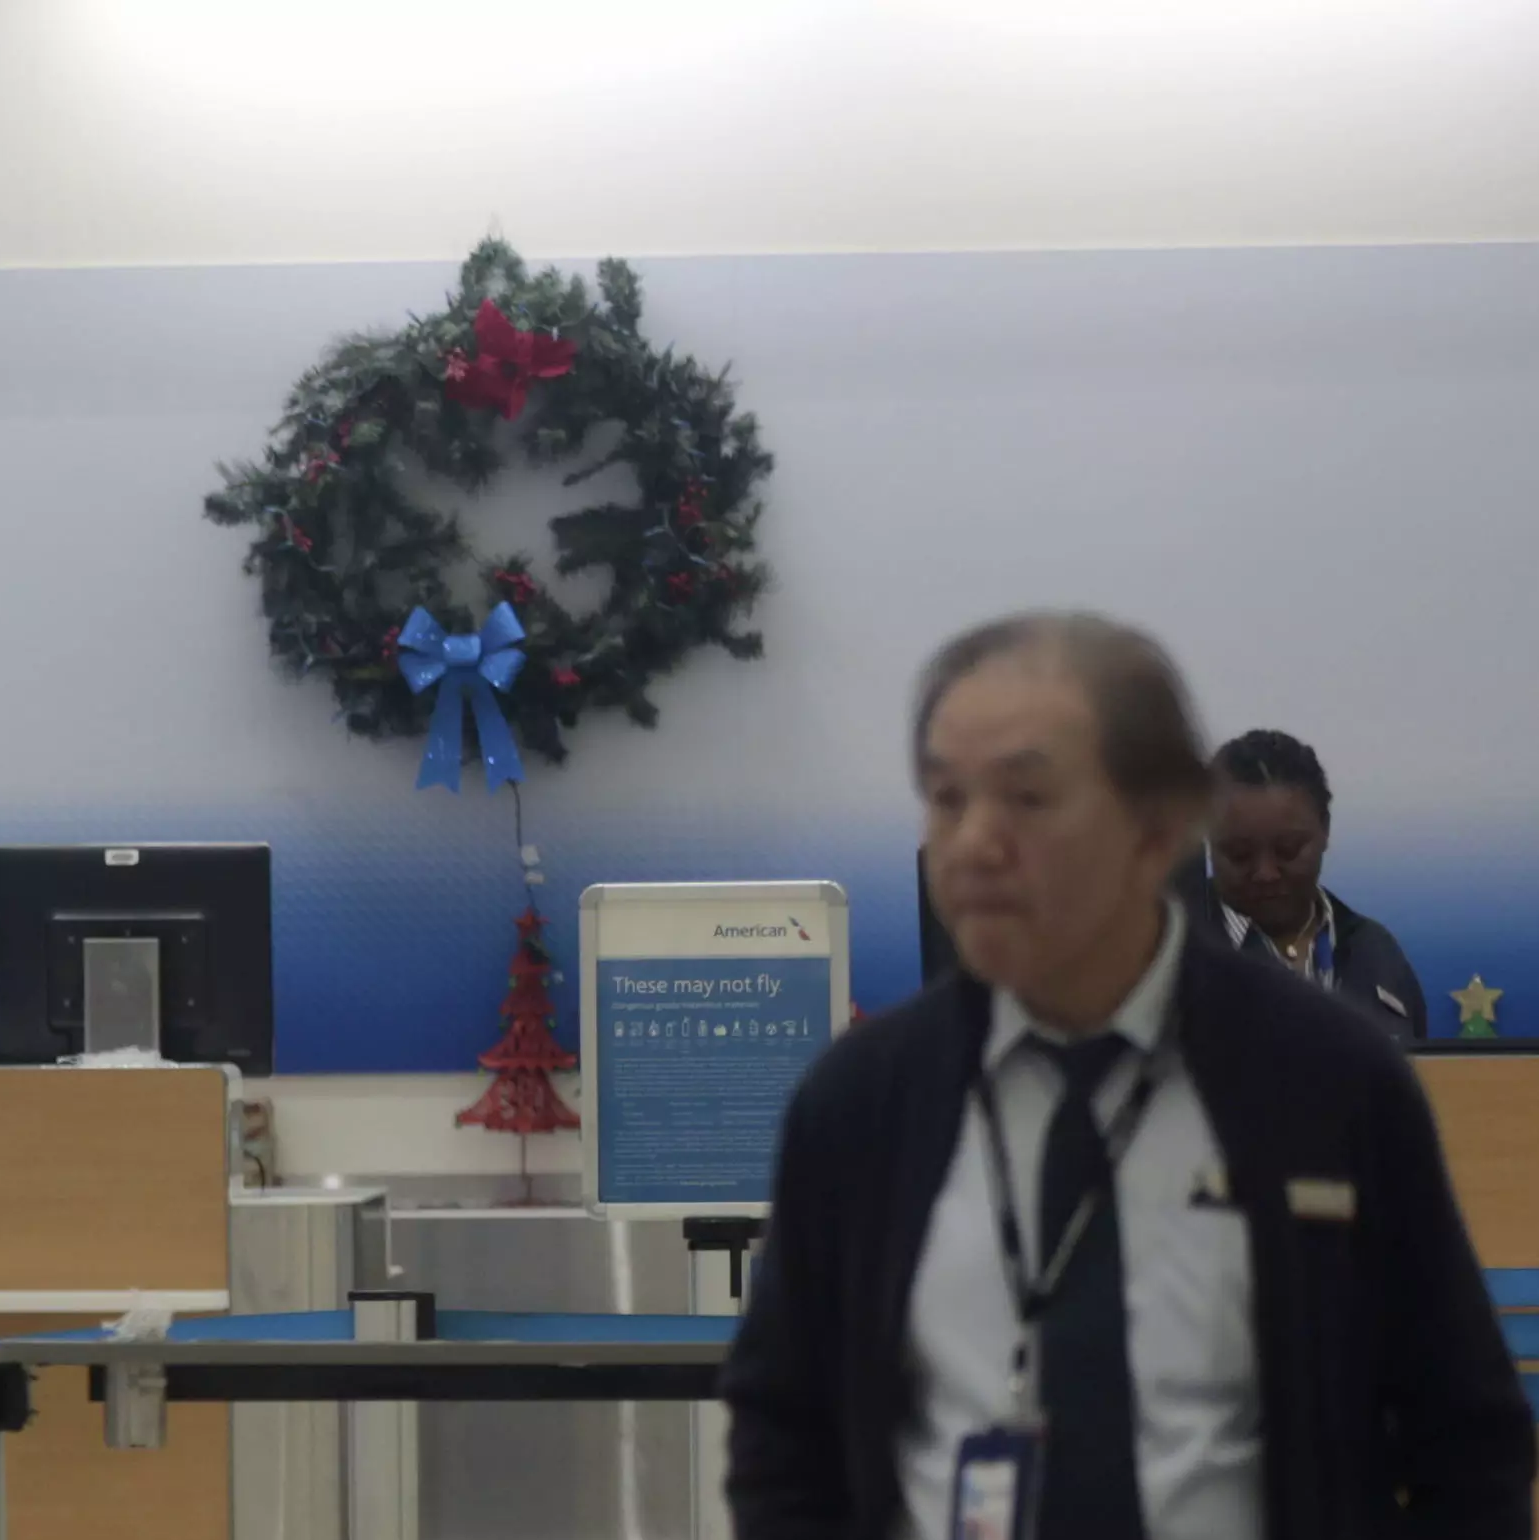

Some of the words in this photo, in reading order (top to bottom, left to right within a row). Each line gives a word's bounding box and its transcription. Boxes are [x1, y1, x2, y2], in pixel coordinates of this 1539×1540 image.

[713, 923, 788, 938] American
[613, 976, 668, 994] These
[673, 979, 714, 998] may
[720, 977, 752, 994] not
